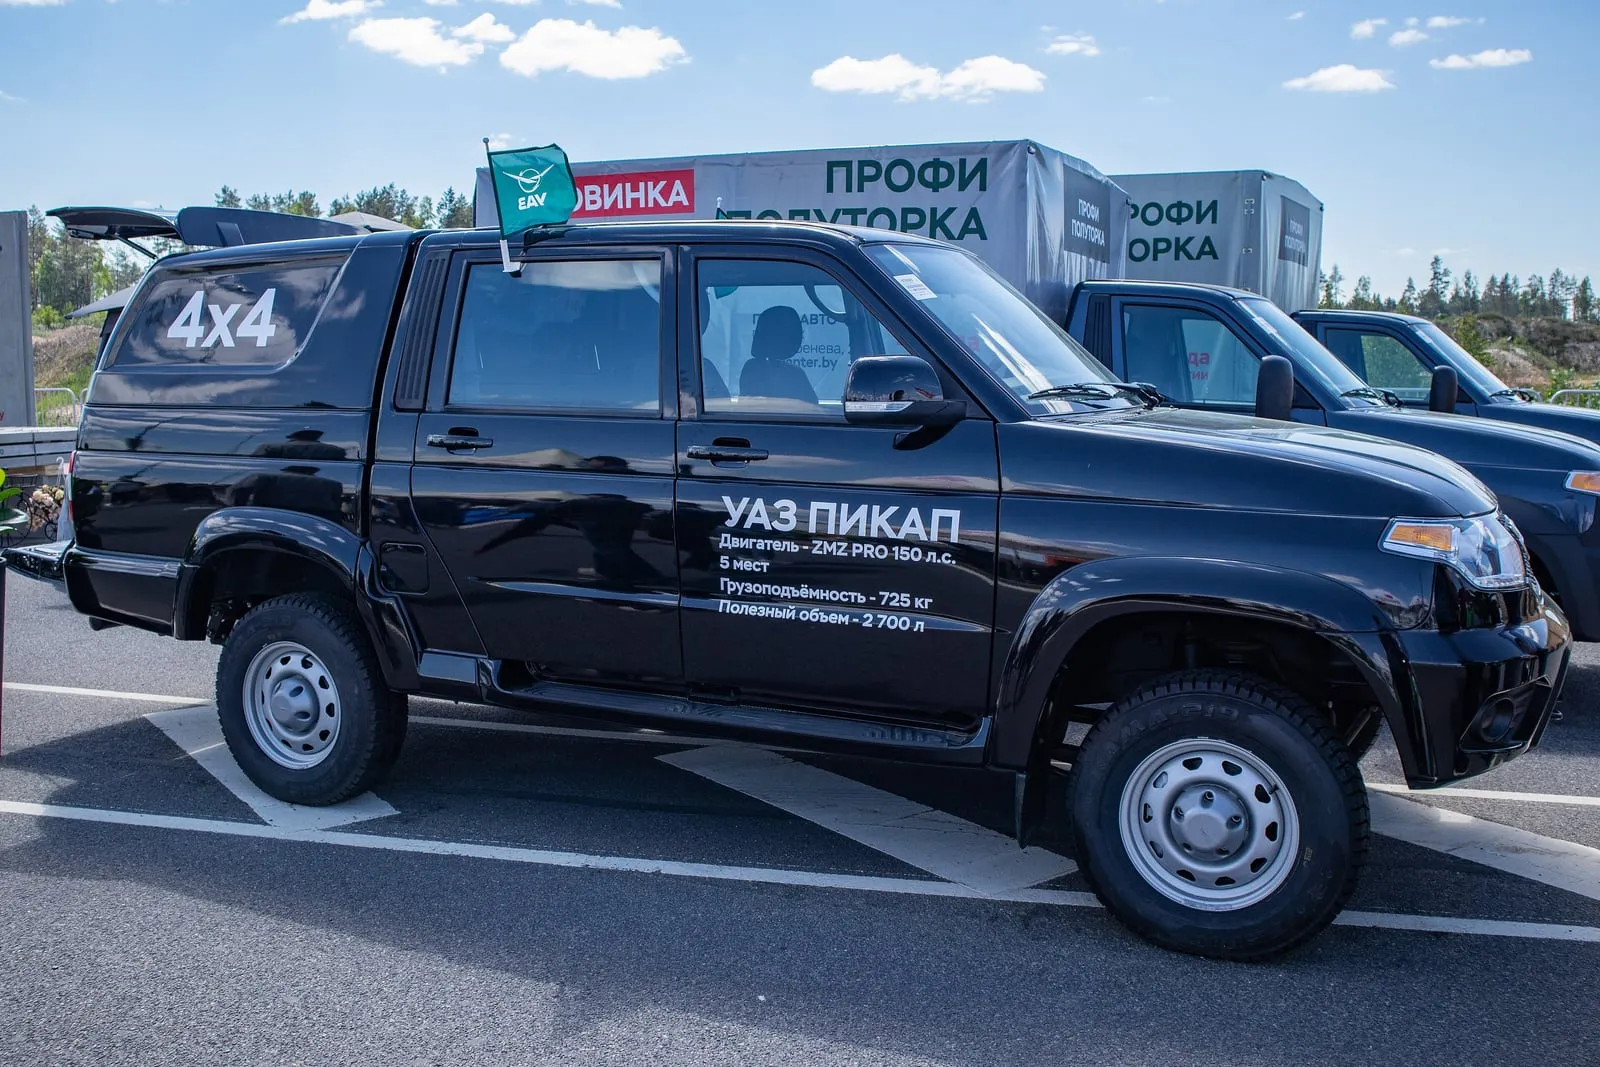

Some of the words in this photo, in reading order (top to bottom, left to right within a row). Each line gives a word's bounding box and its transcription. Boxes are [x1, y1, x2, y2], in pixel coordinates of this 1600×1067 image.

[826, 157, 988, 194] ПРОФИ
[726, 207, 988, 241] ТОРКА
[1078, 198, 1100, 223] ПРОФИ
[1071, 218, 1105, 247] ПОЛУТОРКА
[1128, 235, 1220, 262] ОРКА
[167, 288, 277, 348] 4x4
[721, 495, 797, 532] УАЗ
[808, 501, 961, 543] ПИКАП
[719, 533, 800, 553] Двигатель
[812, 540, 848, 557] ZMZ
[852, 543, 889, 560] PRO
[892, 546, 923, 562] 150
[925, 552, 957, 565] л.с.
[719, 556, 730, 569] 5
[733, 559, 770, 573] мест
[719, 577, 866, 604] Грузоподъёмность
[879, 591, 911, 608] 725
[915, 597, 933, 610] кг
[718, 600, 796, 621] Полезный
[799, 608, 850, 626] объем
[913, 620, 925, 633] л
